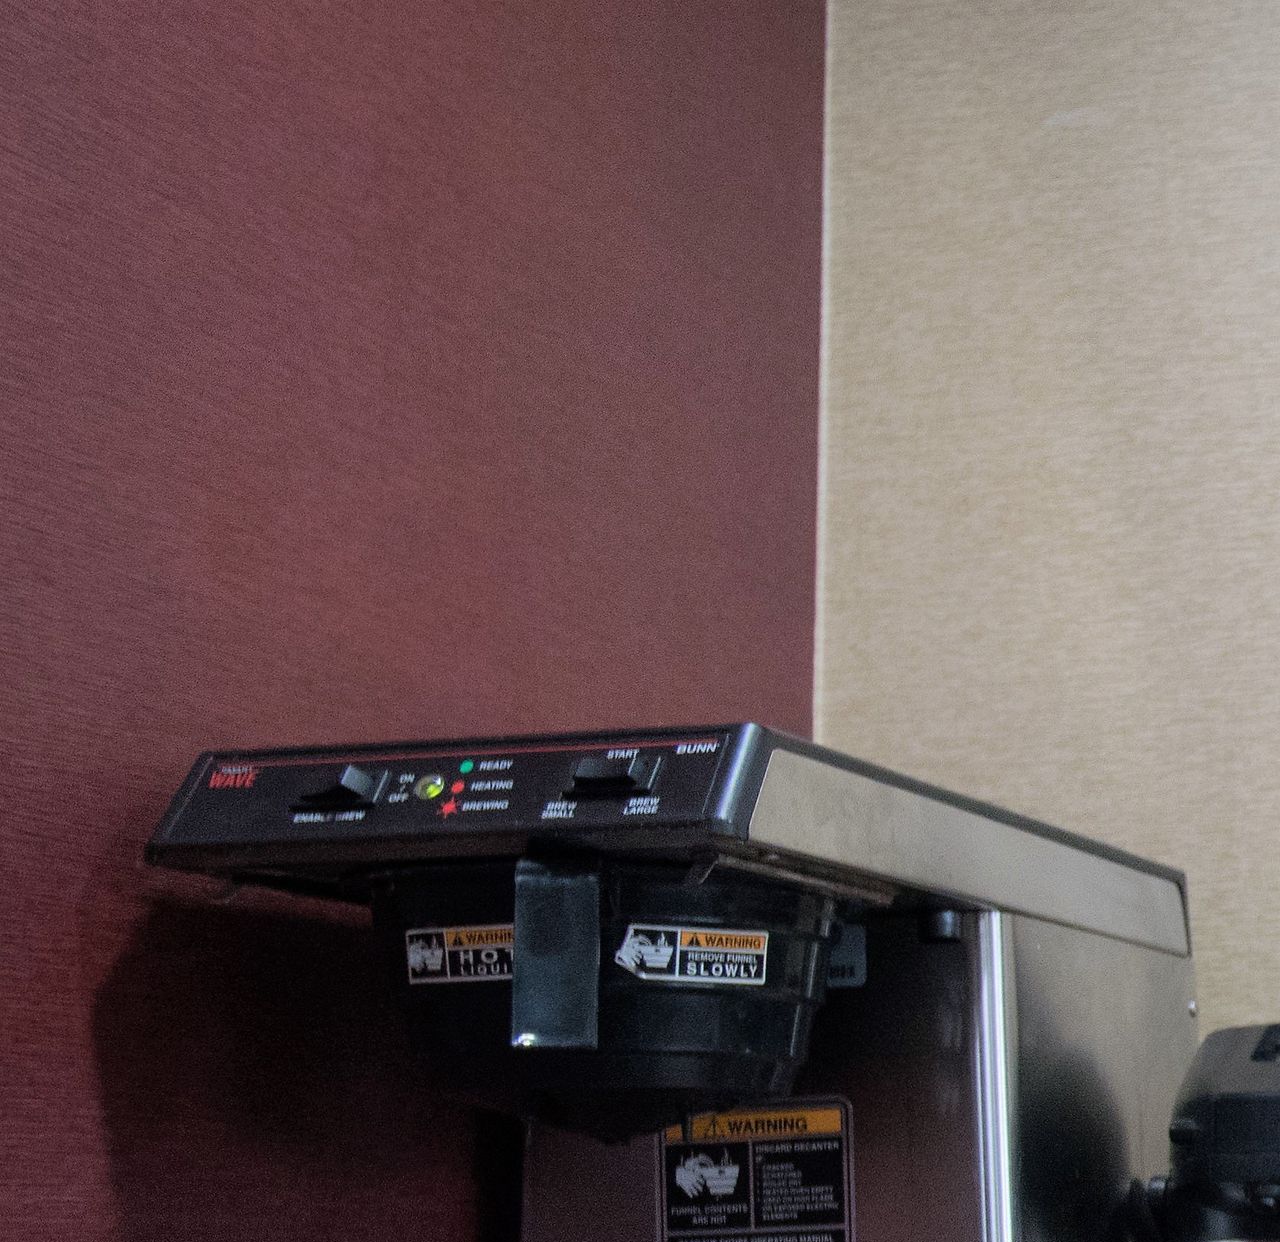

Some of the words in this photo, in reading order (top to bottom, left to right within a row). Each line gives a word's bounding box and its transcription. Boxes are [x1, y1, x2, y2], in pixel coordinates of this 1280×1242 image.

[607, 749, 639, 760] START
[675, 743, 718, 755] BUNN
[479, 760, 513, 771] READY
[208, 771, 257, 789] WAVE
[400, 773, 415, 784] ON
[470, 779, 514, 791] HEATING
[388, 792, 409, 803] OFF
[628, 797, 660, 806] BREW
[462, 799, 510, 811] BREWING
[545, 802, 577, 811] BREW
[622, 805, 659, 816] LARGE
[540, 810, 574, 820] SMALL
[466, 928, 513, 945] WARNI
[705, 935, 762, 948] WARNING
[688, 951, 725, 963] REMOVE
[727, 954, 758, 964] FUNNEL
[460, 962, 508, 976] LIQUI
[687, 961, 758, 978] SLOWLY
[727, 1117, 808, 1134] WARNING
